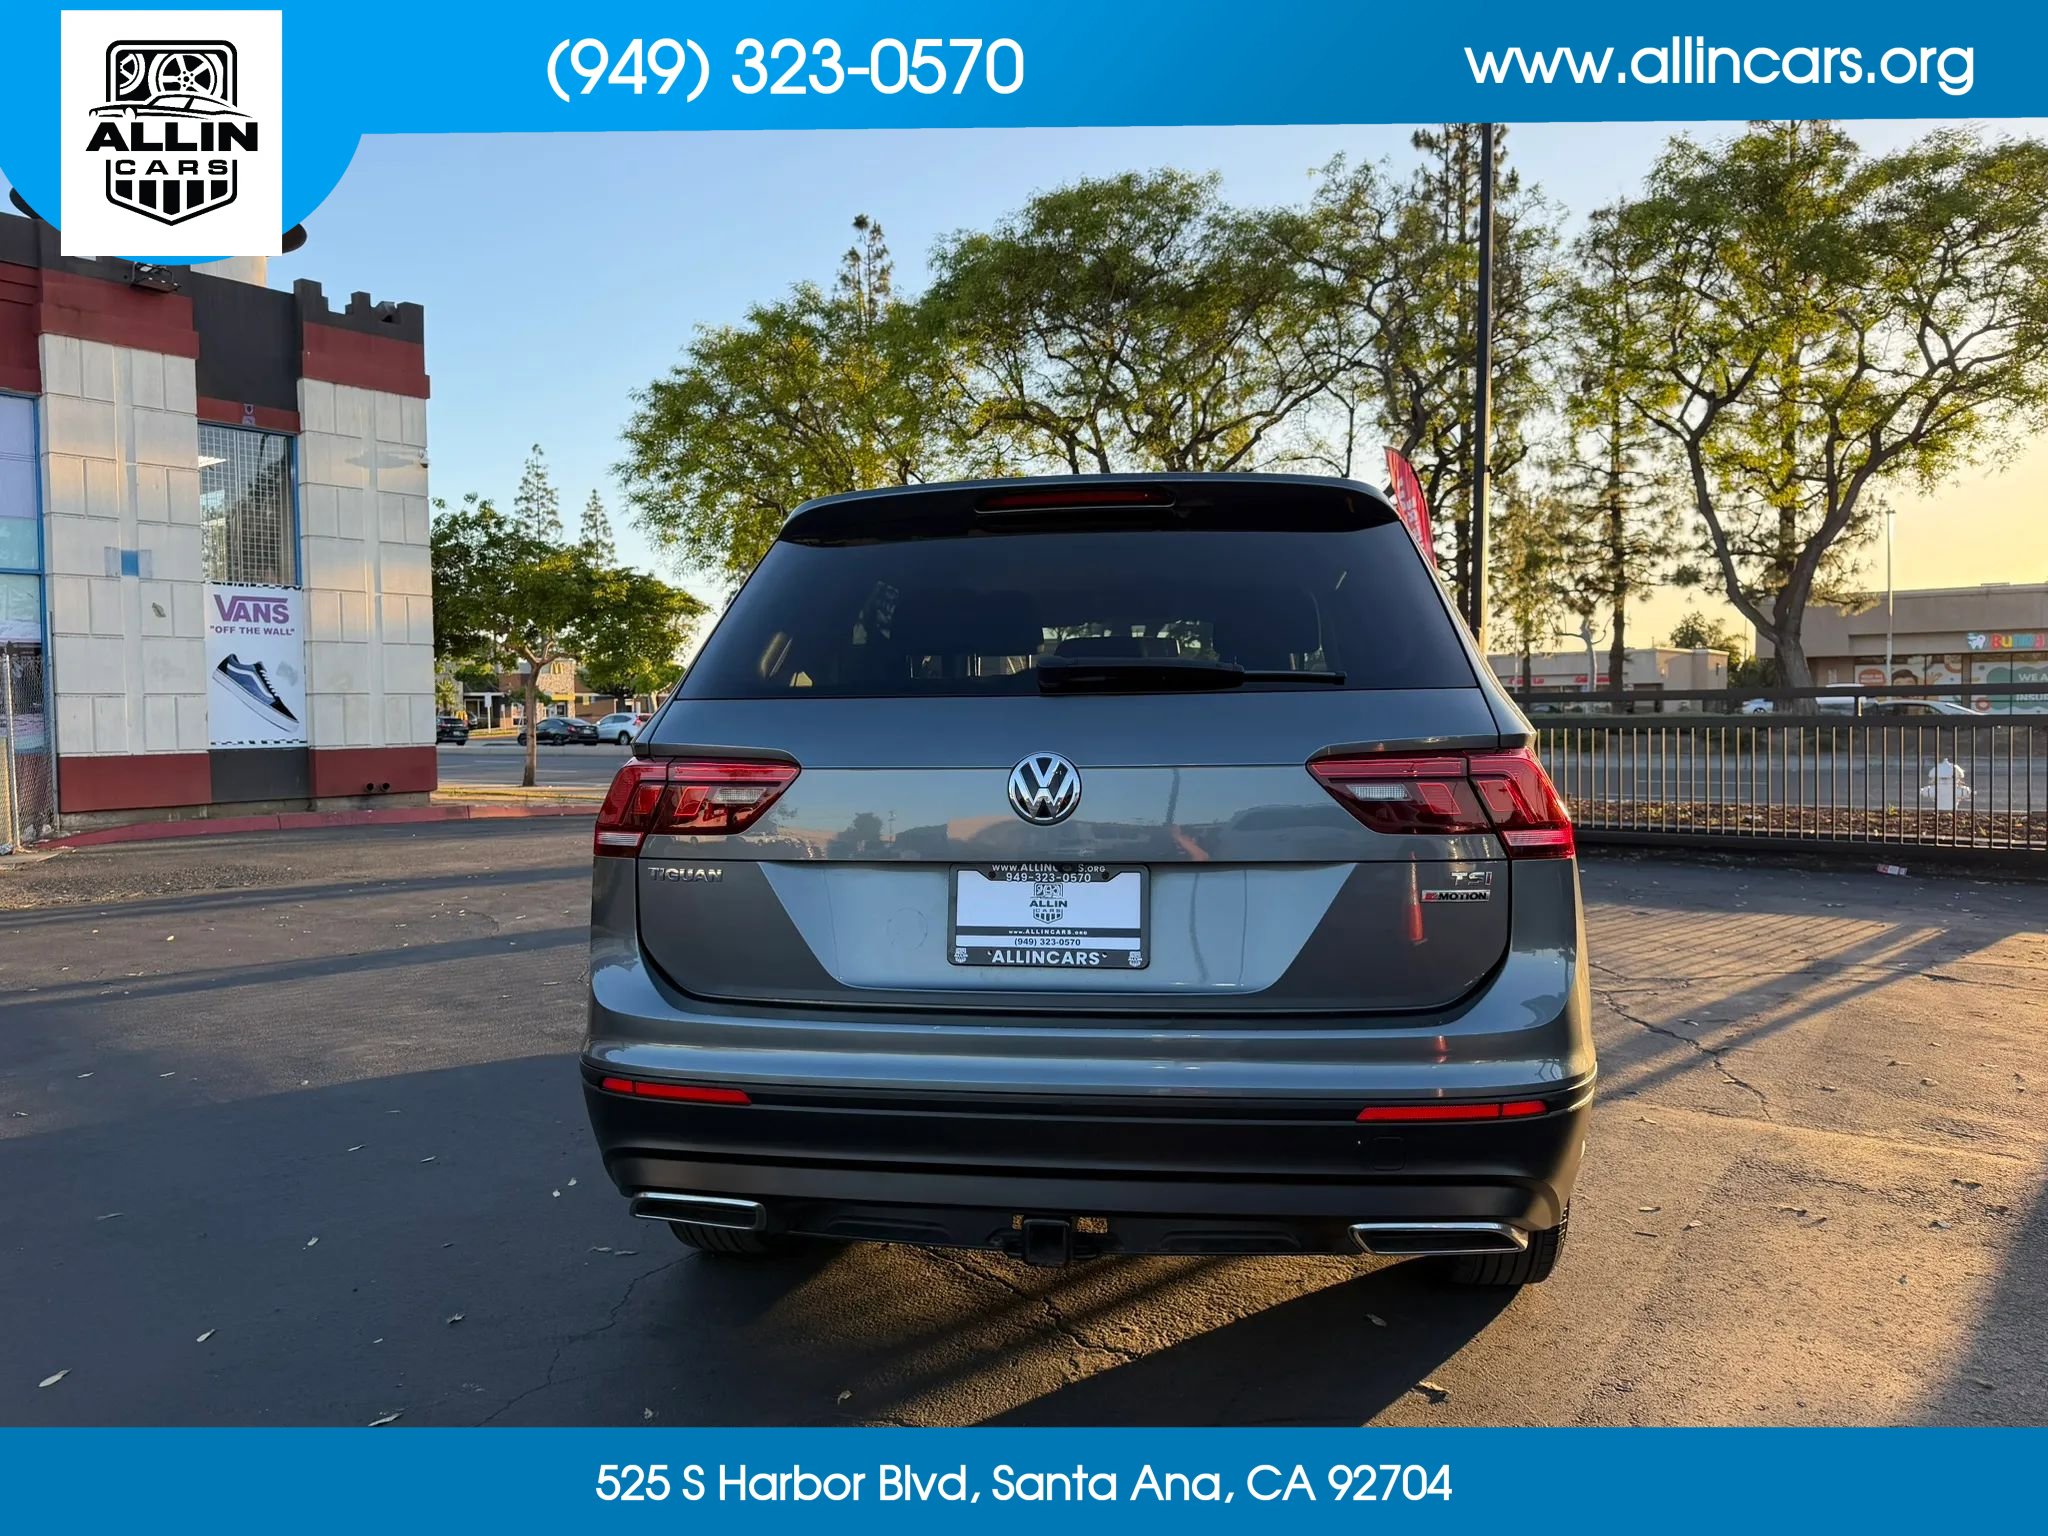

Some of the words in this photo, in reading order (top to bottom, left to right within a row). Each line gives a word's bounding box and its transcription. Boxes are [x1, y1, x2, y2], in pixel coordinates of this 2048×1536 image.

[213, 594, 290, 624] VANS
[210, 625, 236, 634] "OFF
[239, 627, 261, 635] THE
[263, 628, 295, 636] WALL"
[647, 866, 724, 882] TIGUAN
[1006, 872, 1092, 883] 949-323-0570
[1451, 871, 1493, 886] TSI
[1029, 900, 1068, 908] ALLIN
[1014, 938, 1038, 947] (949)
[1039, 938, 1081, 947] 323-0570
[991, 949, 1101, 966] ALLINCARS
